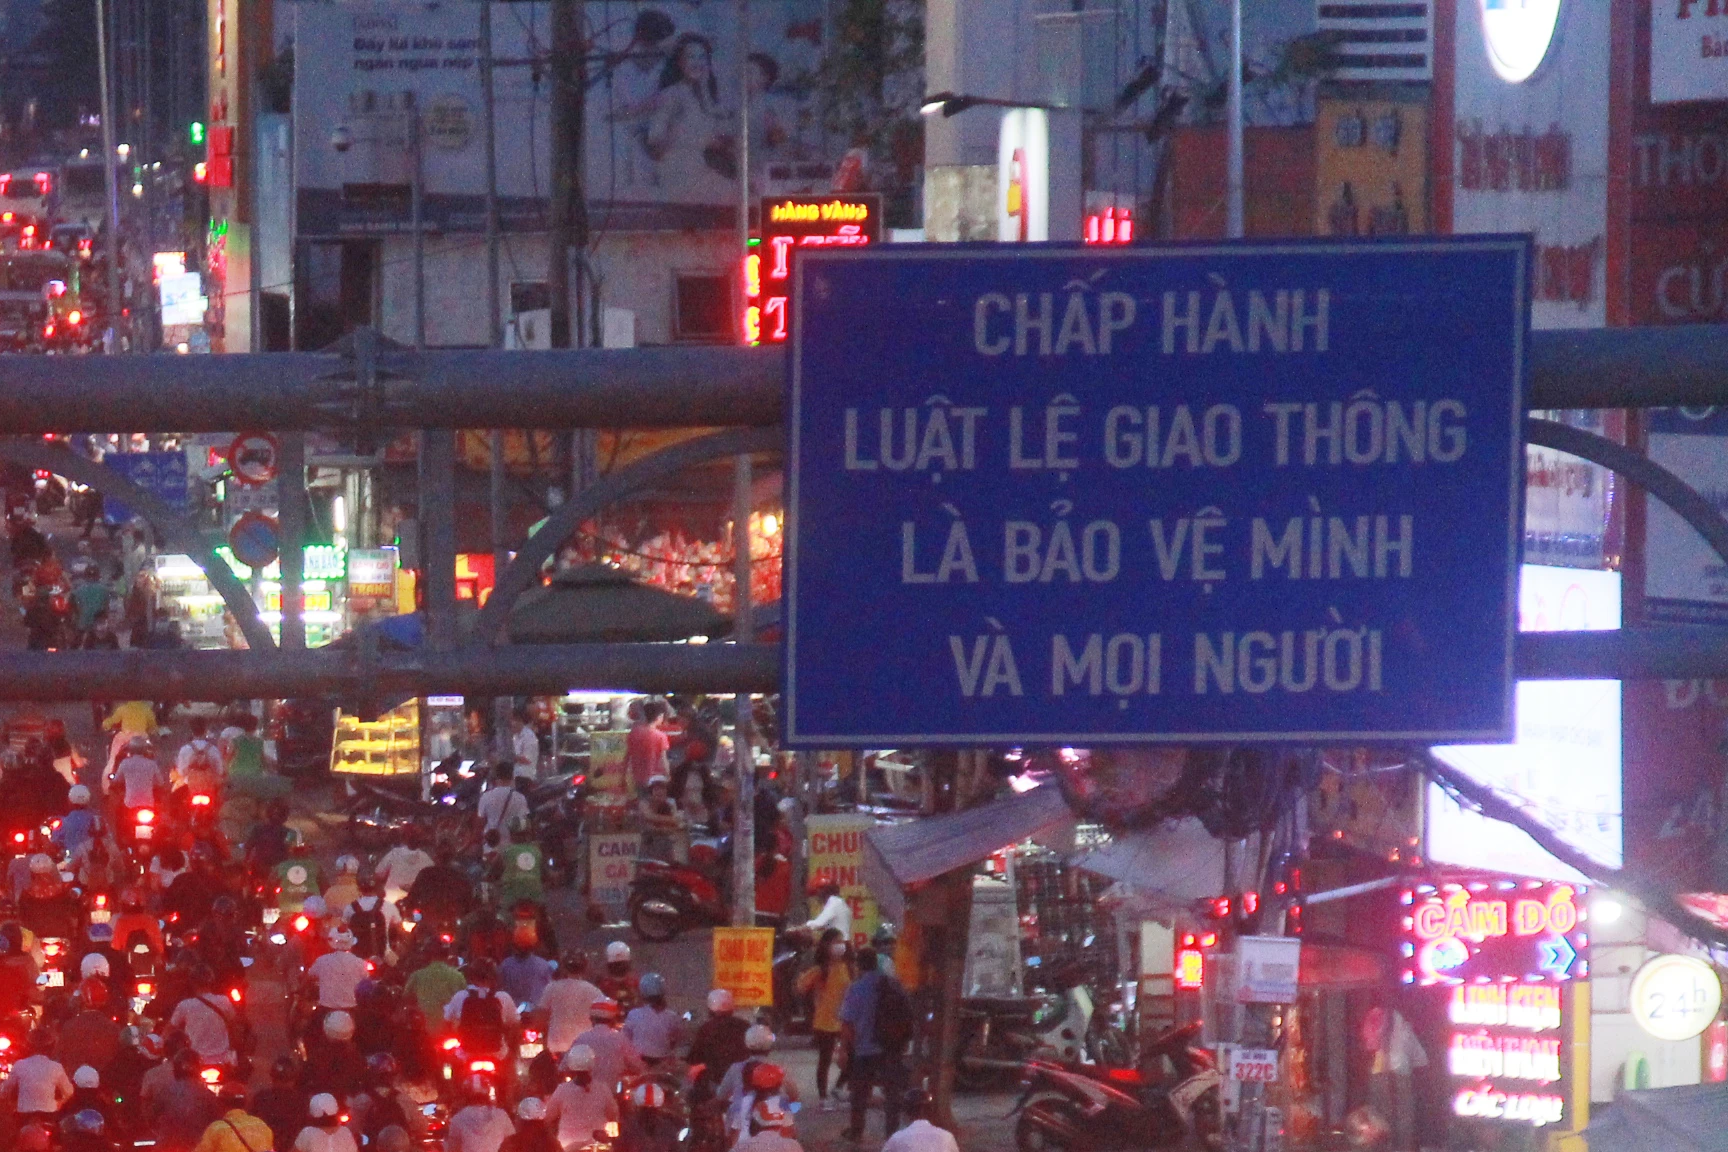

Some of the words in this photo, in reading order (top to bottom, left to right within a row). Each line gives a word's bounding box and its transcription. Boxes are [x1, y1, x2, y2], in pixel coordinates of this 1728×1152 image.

[974, 269, 1137, 356] CHẤP
[1161, 272, 1330, 354] HÀNH
[844, 394, 987, 483] LUẬT
[1009, 393, 1080, 482] LỆ
[1104, 403, 1243, 468] GIAO
[1270, 390, 1467, 465] THÔNG
[901, 503, 979, 584] LÀ
[1004, 499, 1121, 584] BẢO
[1149, 506, 1227, 594] VỆ
[1251, 497, 1413, 580] MÌNH
[949, 617, 1024, 697] VÀ
[1052, 633, 1162, 709] MỌI
[1195, 607, 1383, 694] NGƯỜI
